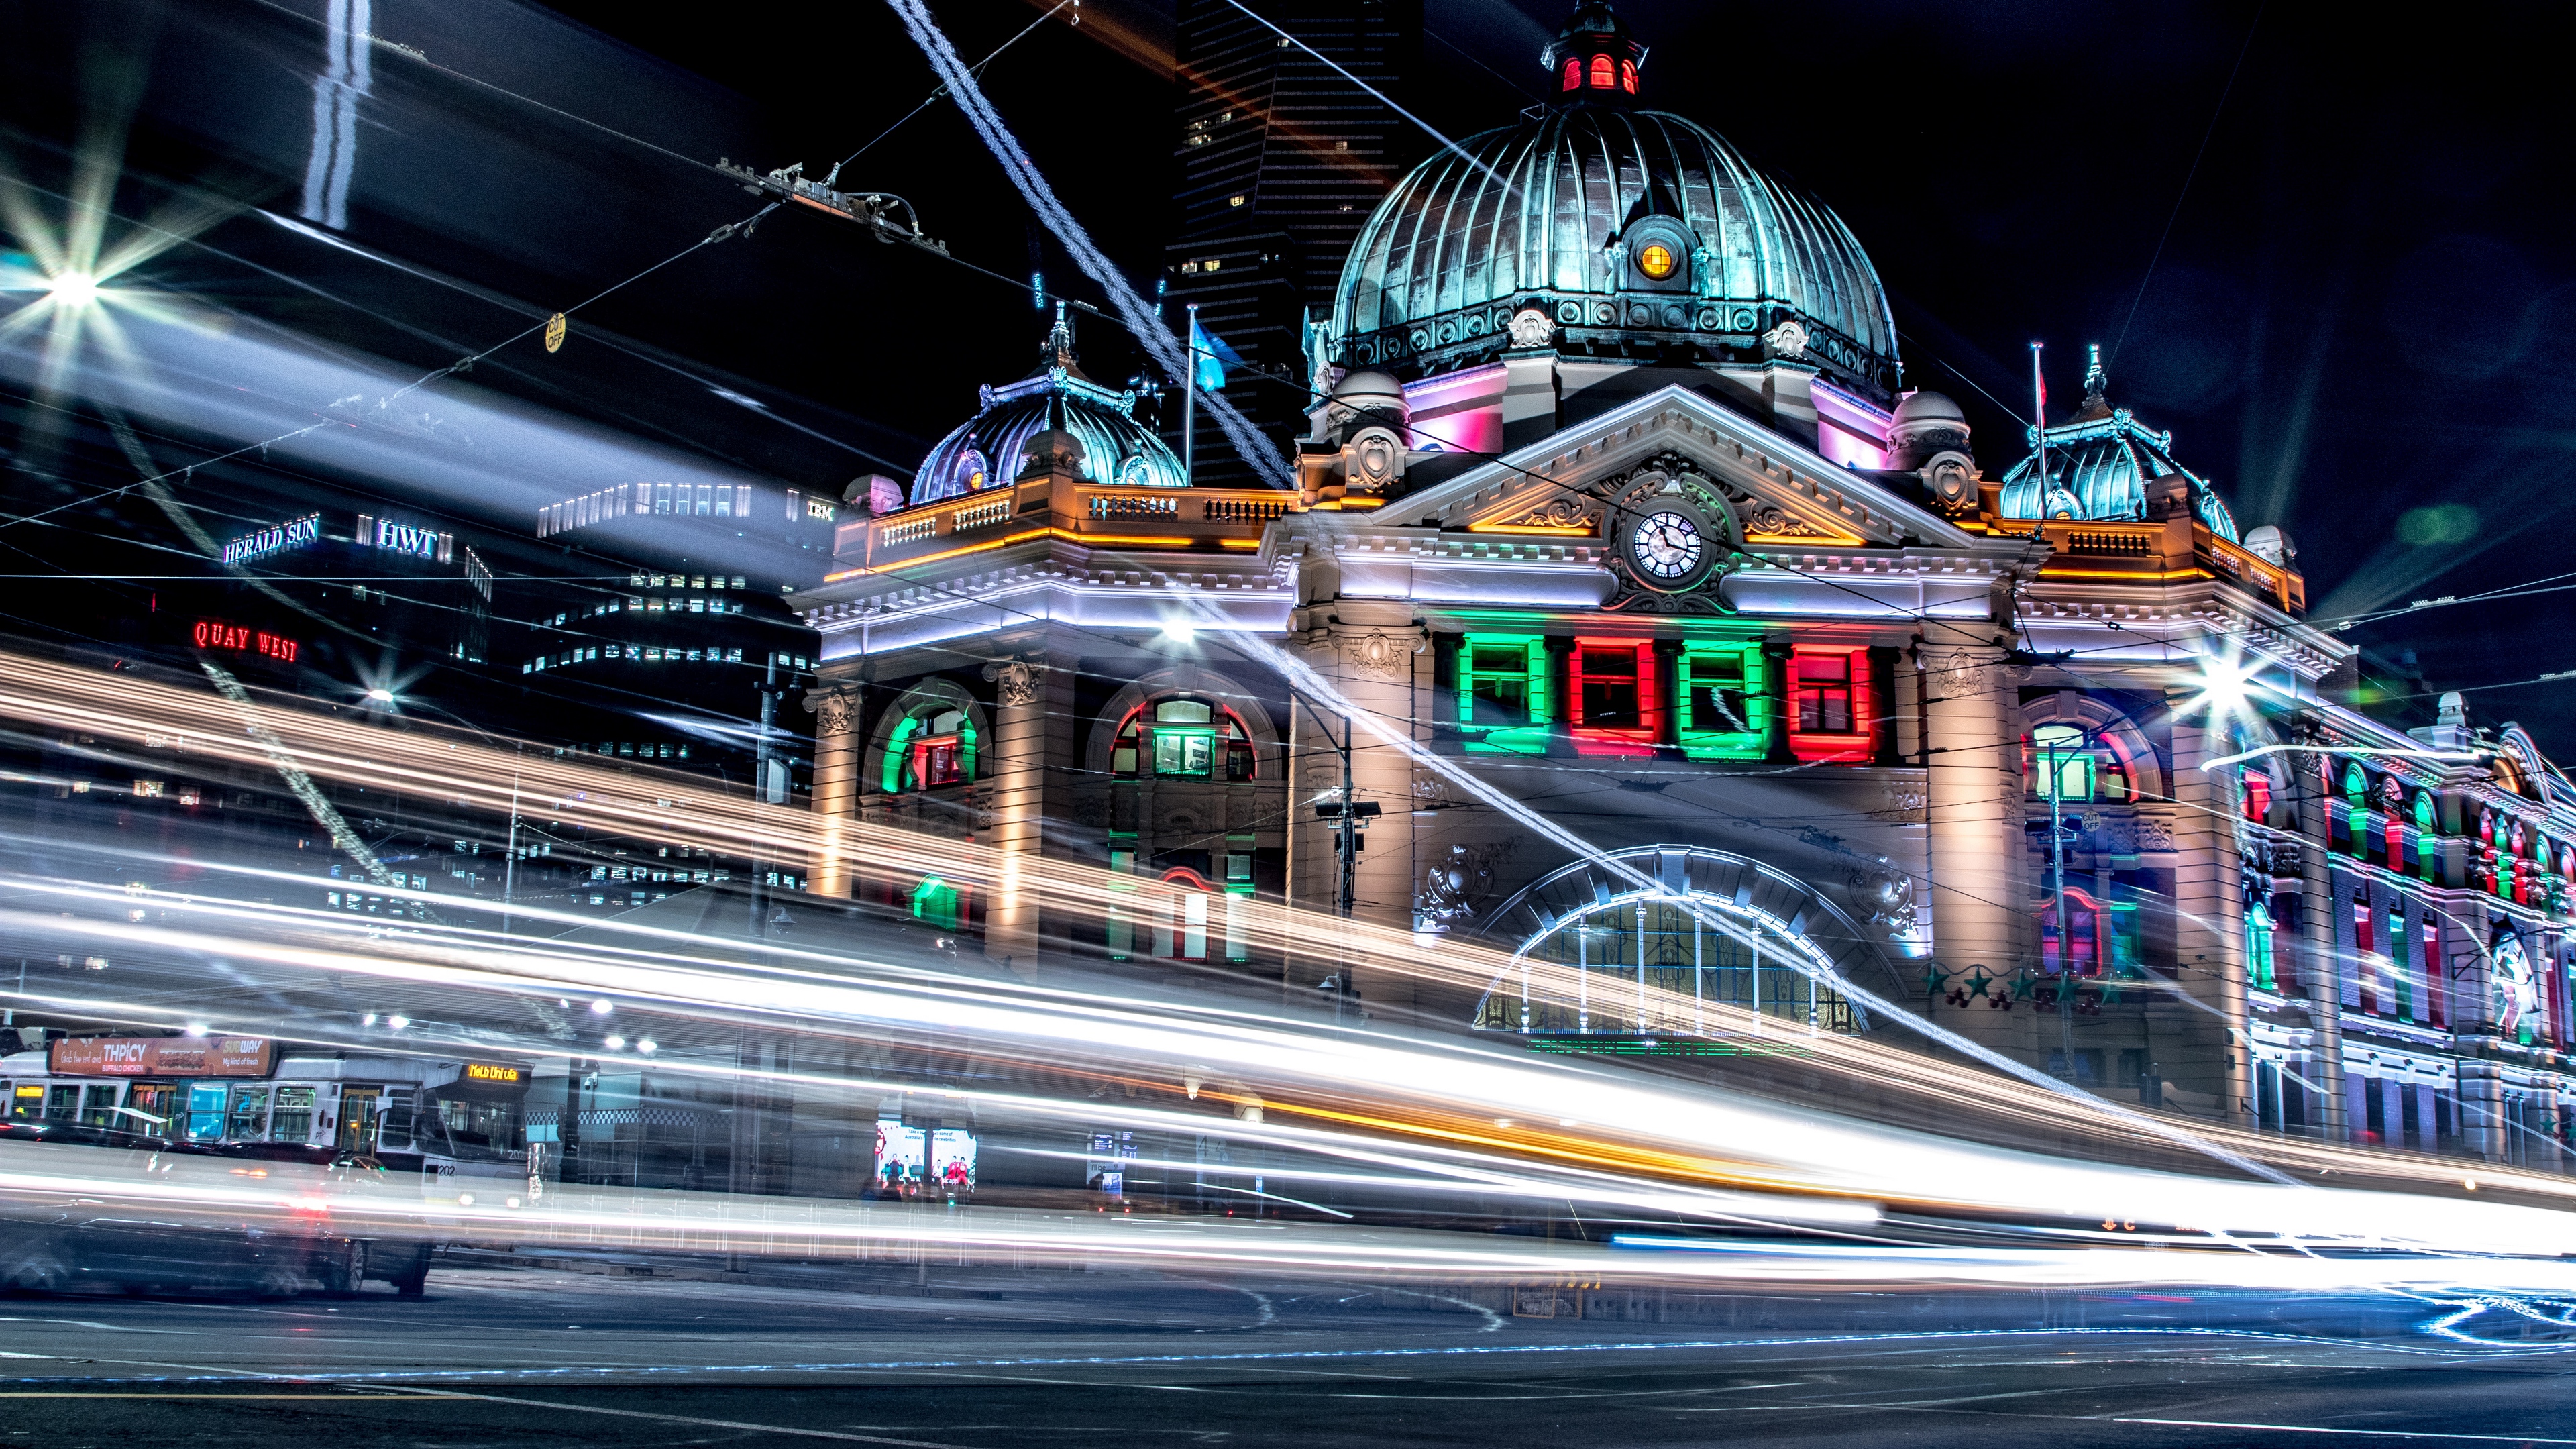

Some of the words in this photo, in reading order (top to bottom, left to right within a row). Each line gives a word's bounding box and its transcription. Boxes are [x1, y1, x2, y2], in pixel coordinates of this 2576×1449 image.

[549, 317, 564, 333] CUT
[548, 332, 563, 348] OFF
[807, 500, 835, 521] IBM
[224, 529, 283, 564] HERALD
[286, 518, 319, 544] SUN
[378, 521, 437, 555] HWT
[195, 623, 249, 649] QUAY
[258, 632, 297, 662] WEST
[223, 1040, 263, 1053] SUBWAY
[223, 1057, 230, 1067] My
[230, 1057, 240, 1065] kind
[241, 1057, 246, 1065] of
[246, 1057, 258, 1065] fresh
[508, 1150, 525, 1160] 202
[439, 1165, 455, 1176] 202
